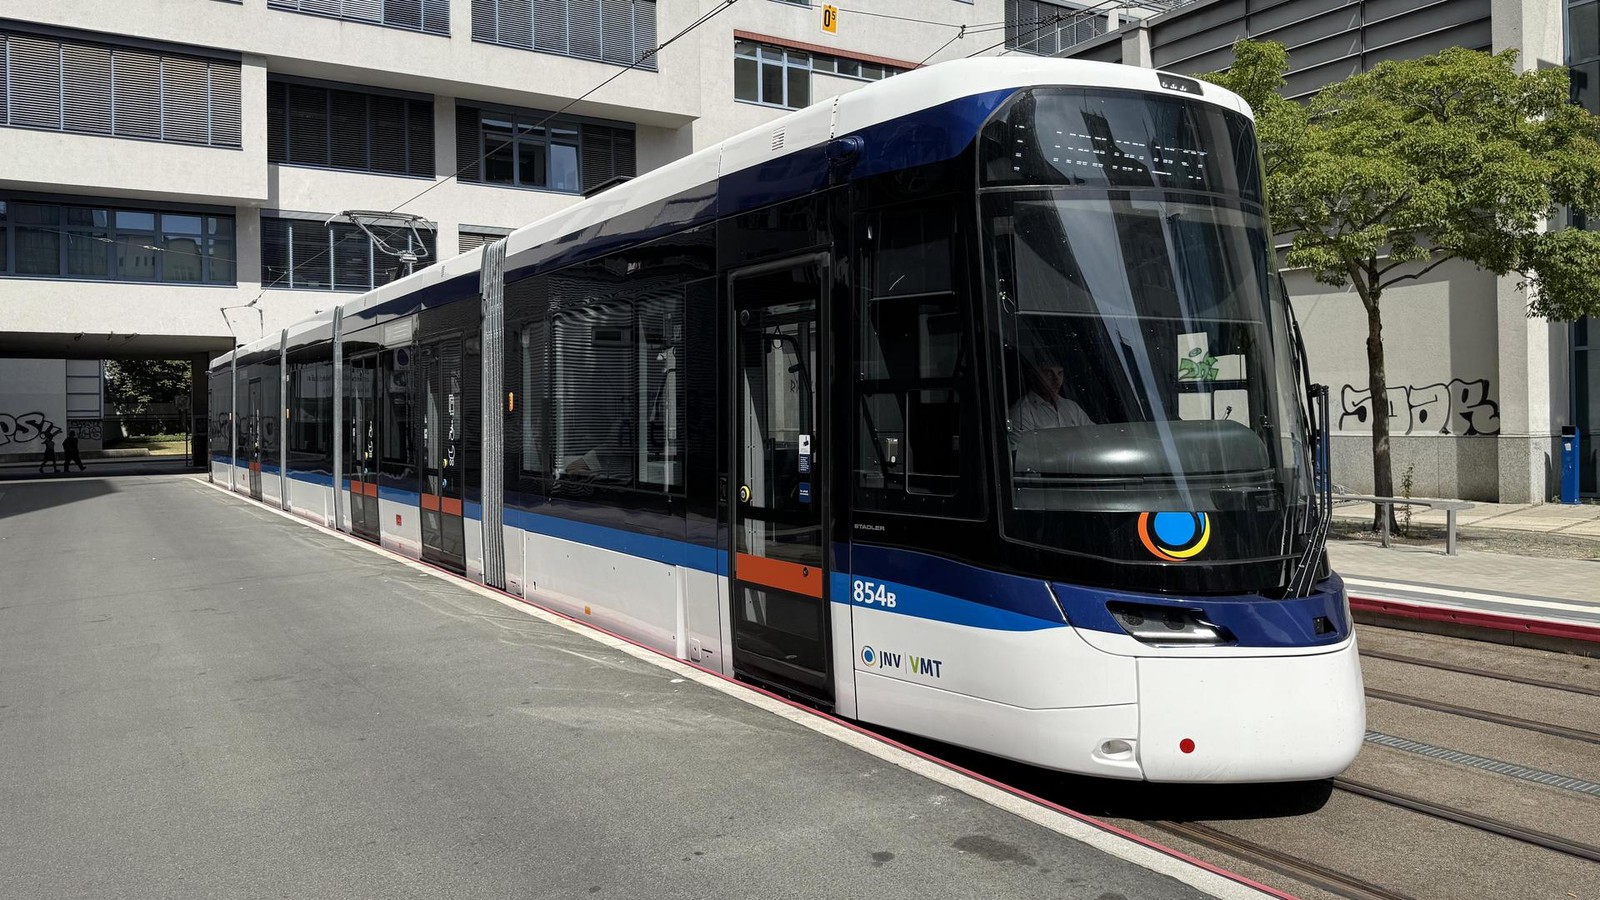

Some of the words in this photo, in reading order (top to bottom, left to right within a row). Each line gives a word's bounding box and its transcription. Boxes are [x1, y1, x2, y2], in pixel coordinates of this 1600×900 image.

[854, 523, 886, 531] STADLER
[854, 580, 896, 608] 854B
[880, 651, 901, 669] JNV
[909, 655, 942, 678] VMT
